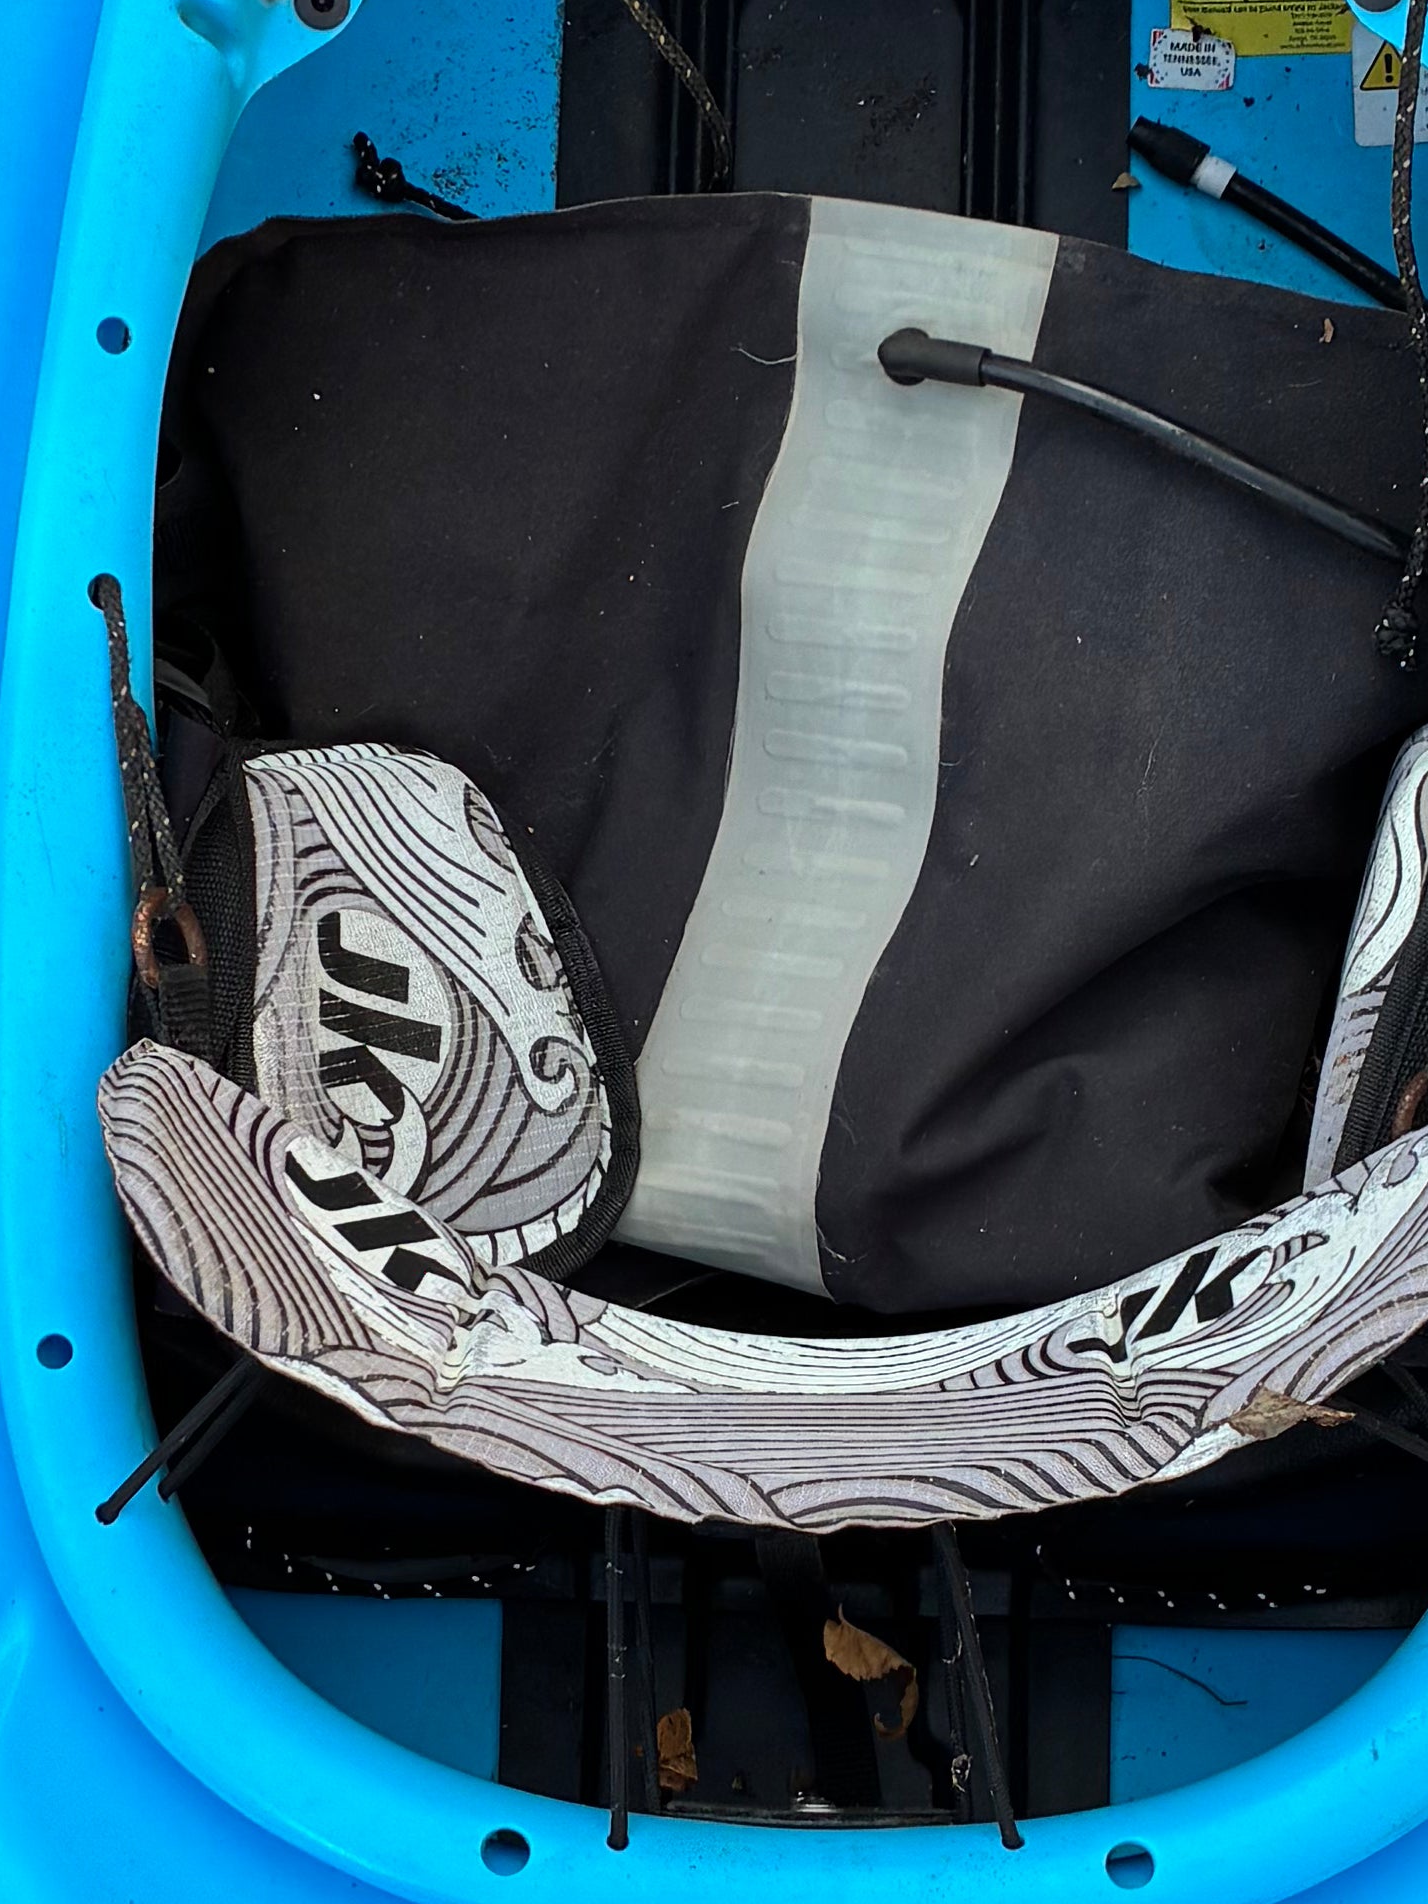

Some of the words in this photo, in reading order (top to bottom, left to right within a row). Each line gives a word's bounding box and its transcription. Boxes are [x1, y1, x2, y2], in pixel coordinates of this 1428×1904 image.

[1169, 42, 1202, 53] MADE
[1204, 42, 1216, 53] IN
[1180, 67, 1202, 77] USA
